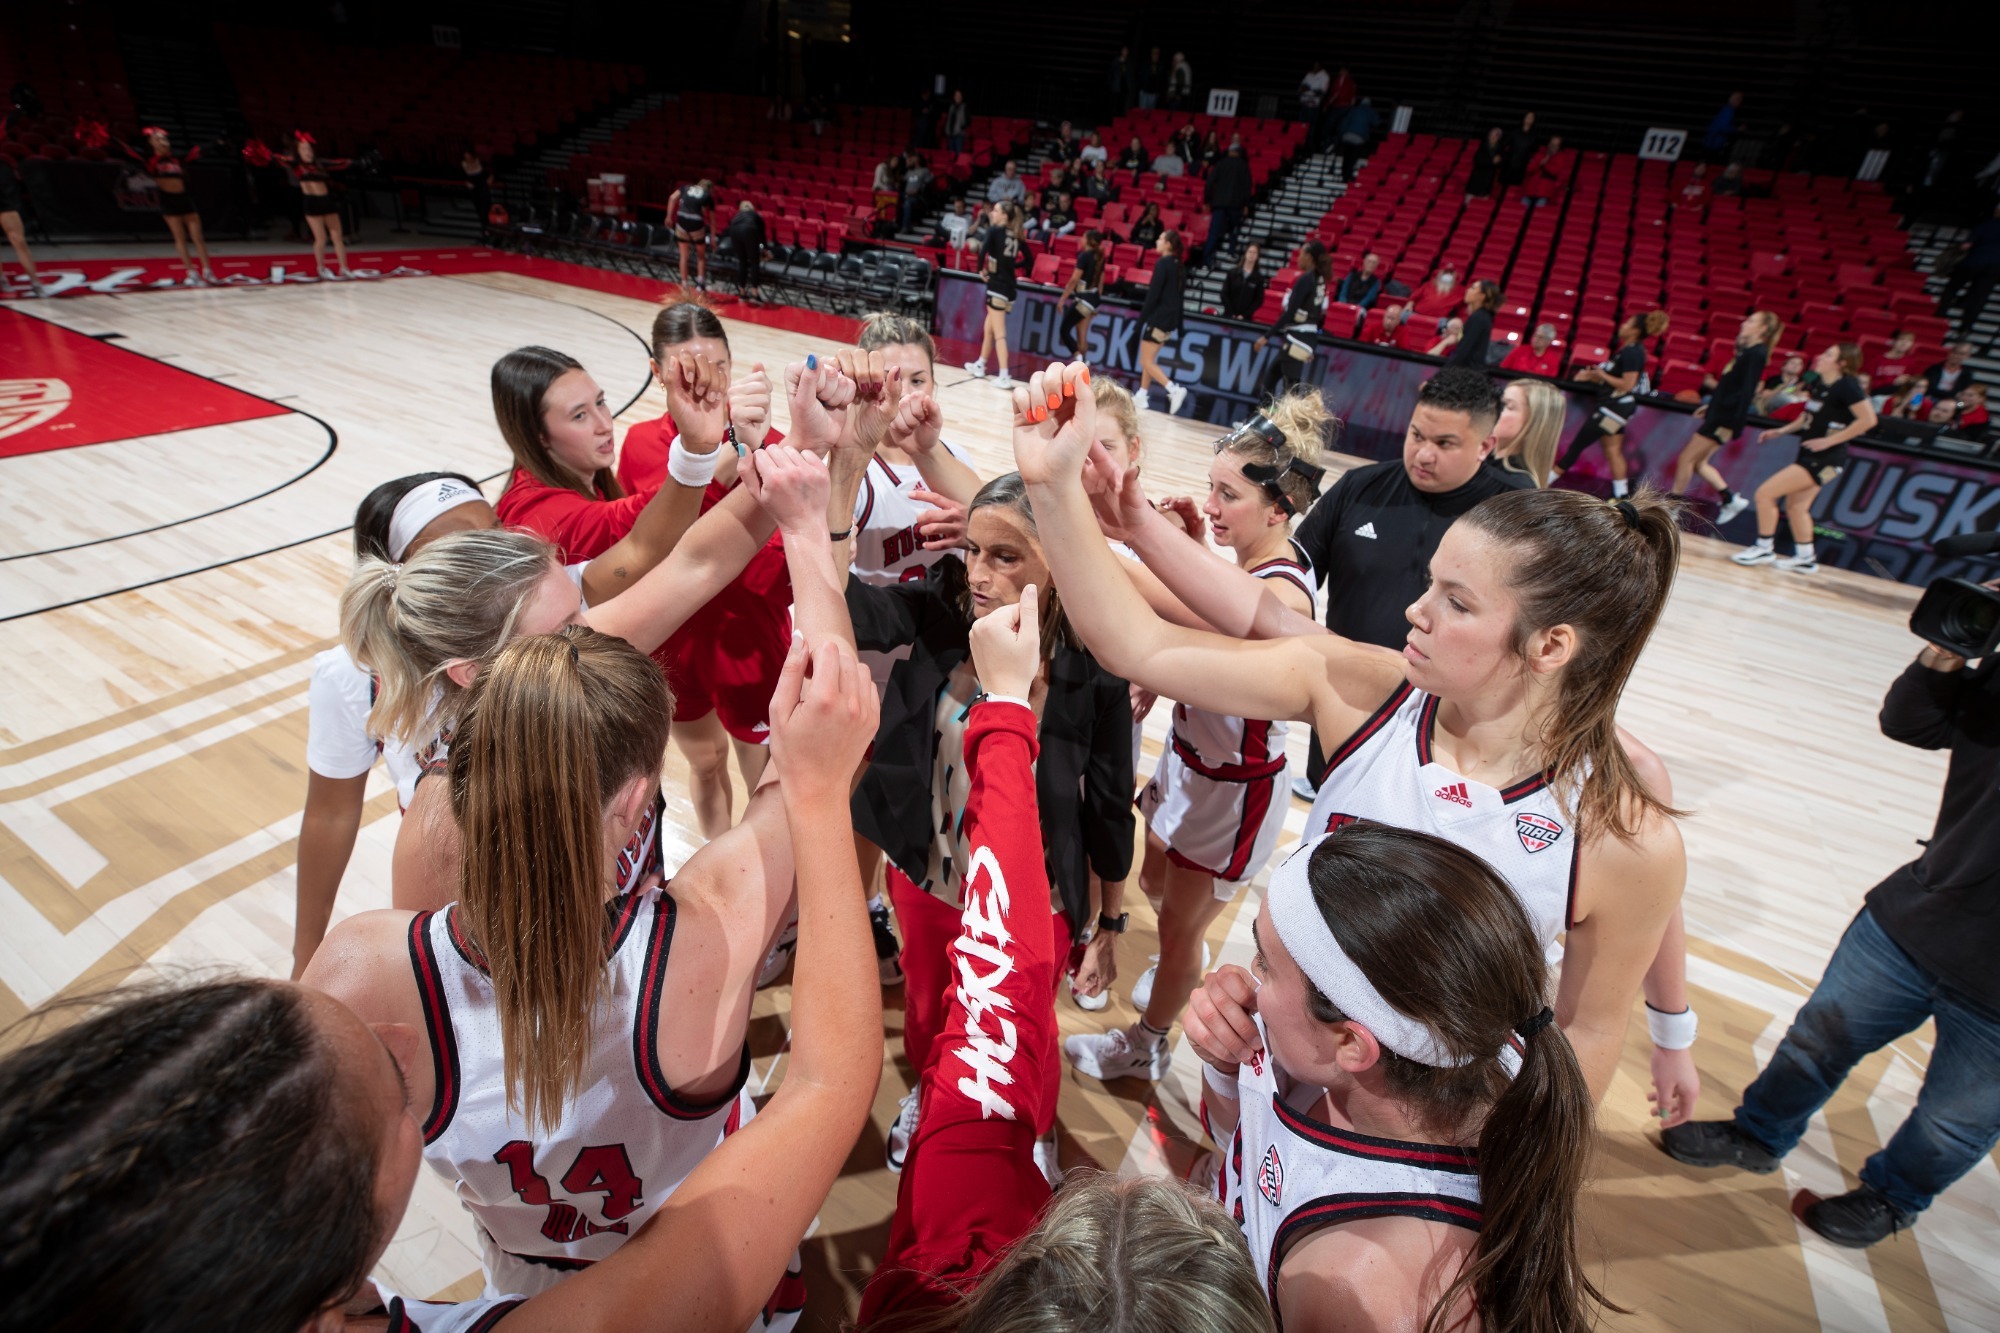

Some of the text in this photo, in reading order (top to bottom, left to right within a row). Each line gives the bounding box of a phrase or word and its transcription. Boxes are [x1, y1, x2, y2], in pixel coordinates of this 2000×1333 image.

[1213, 94, 1235, 111] 111
[1647, 133, 1681, 154] 112
[1003, 237, 1019, 258] 21
[438, 488, 469, 502] adidas
[1811, 457, 2000, 544] USK
[1434, 789, 1473, 809] adidas
[1515, 820, 1560, 842] MAC
[493, 1140, 645, 1220] 14
